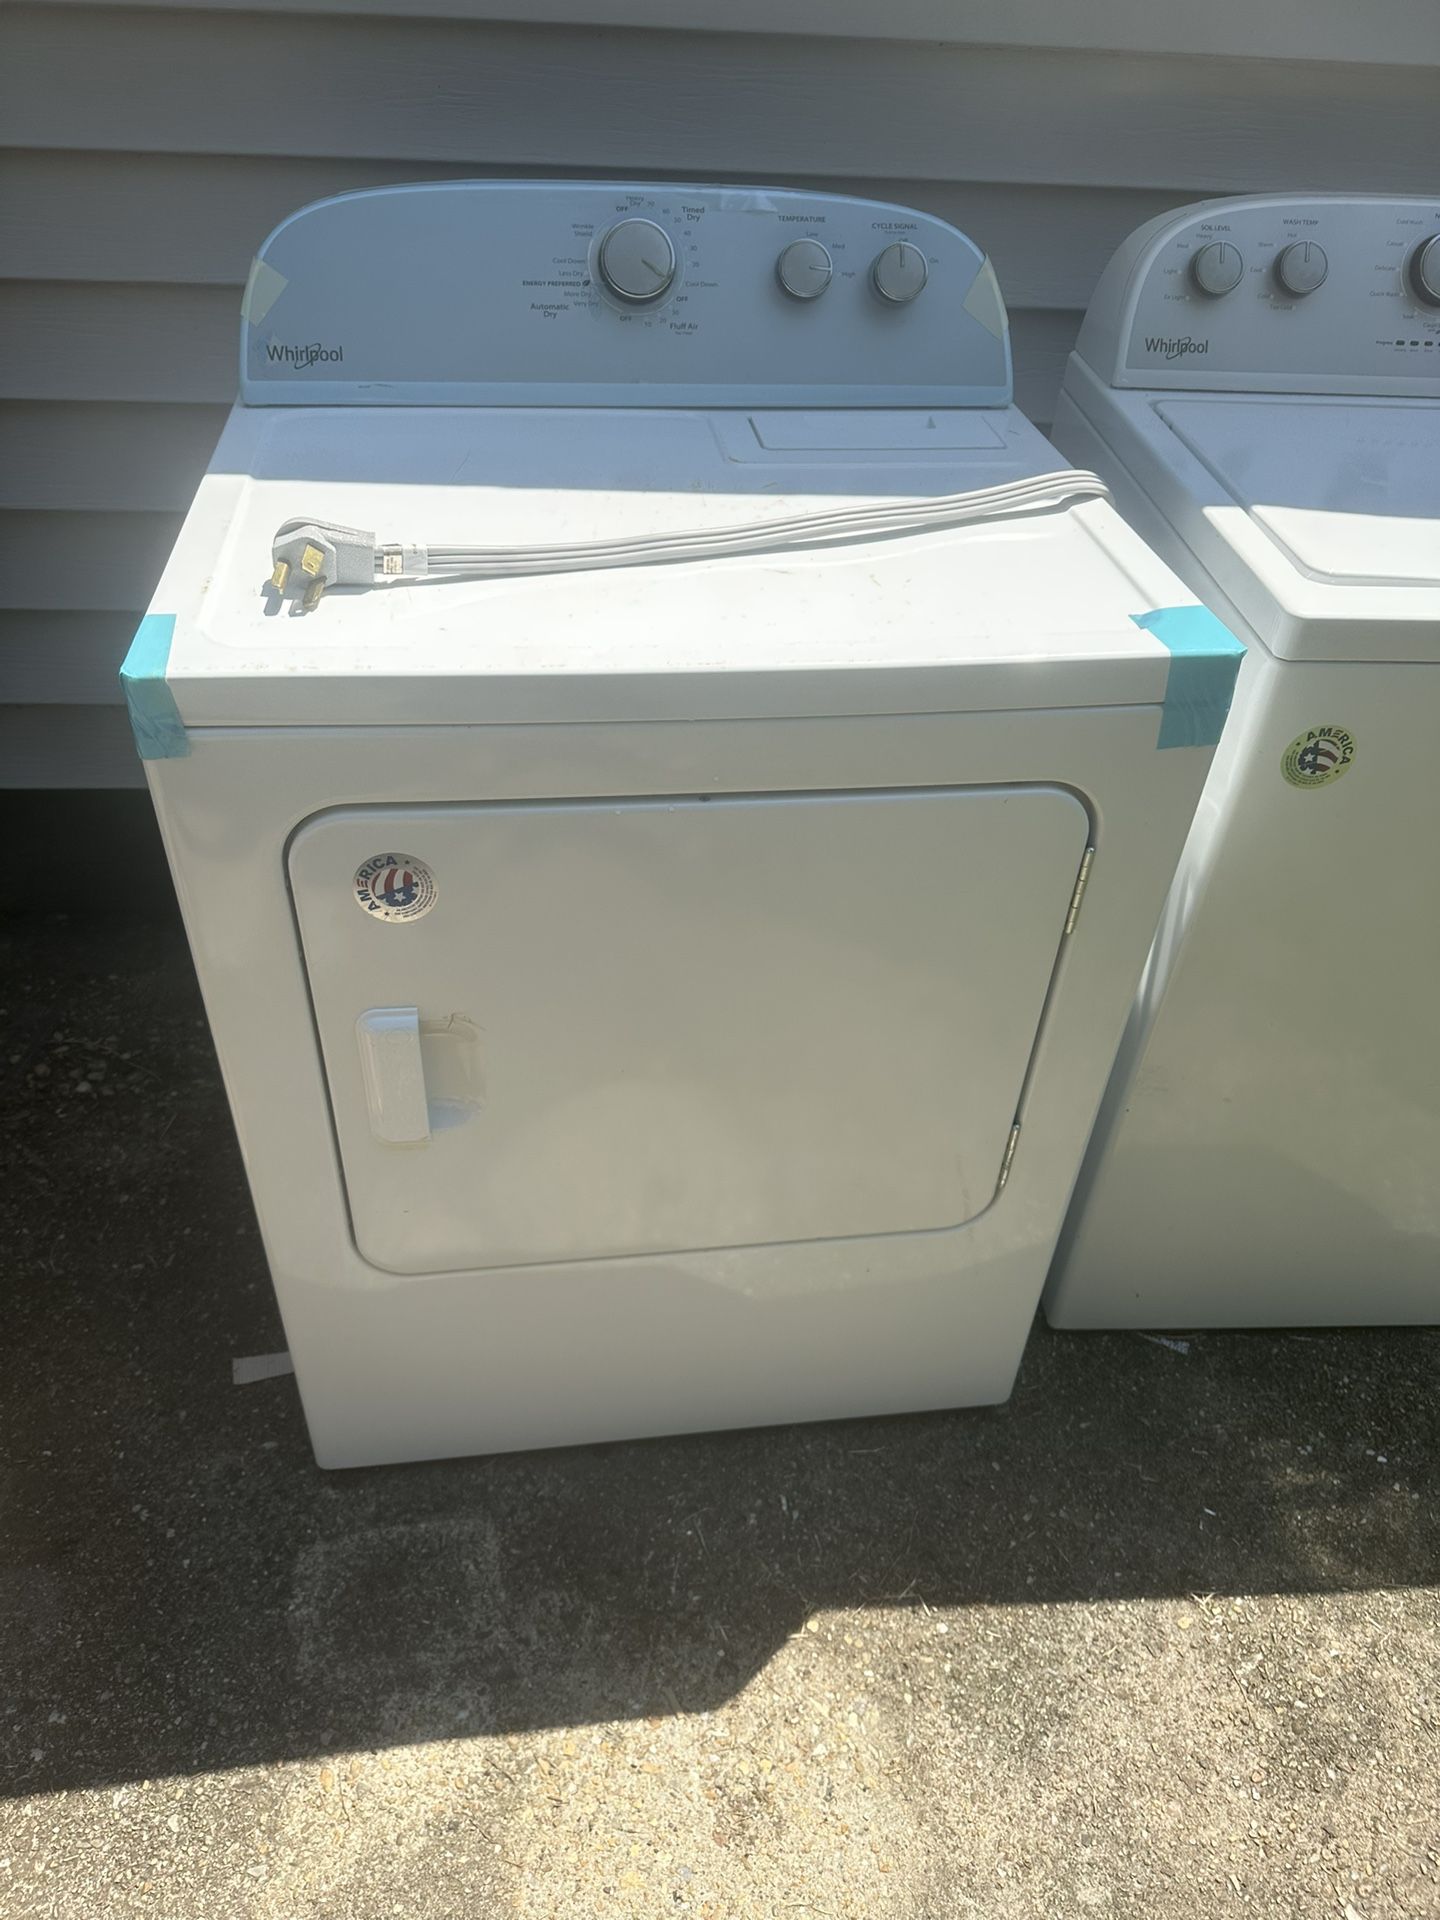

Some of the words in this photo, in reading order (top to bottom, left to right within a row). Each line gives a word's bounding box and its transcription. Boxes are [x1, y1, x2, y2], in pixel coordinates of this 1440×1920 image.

[687, 213, 700, 222] Dry
[778, 215, 826, 223] TEMPERATURE
[872, 222, 893, 230] CYCLE
[573, 271, 584, 279] Dry
[544, 311, 557, 319] Dry
[670, 322, 686, 331] Fluff
[687, 323, 698, 331] Air
[1145, 337, 1209, 360] Whirlpool
[266, 342, 344, 370] Whirlpool
[1306, 727, 1354, 765] AMERICA
[356, 855, 398, 911] AMERICA
